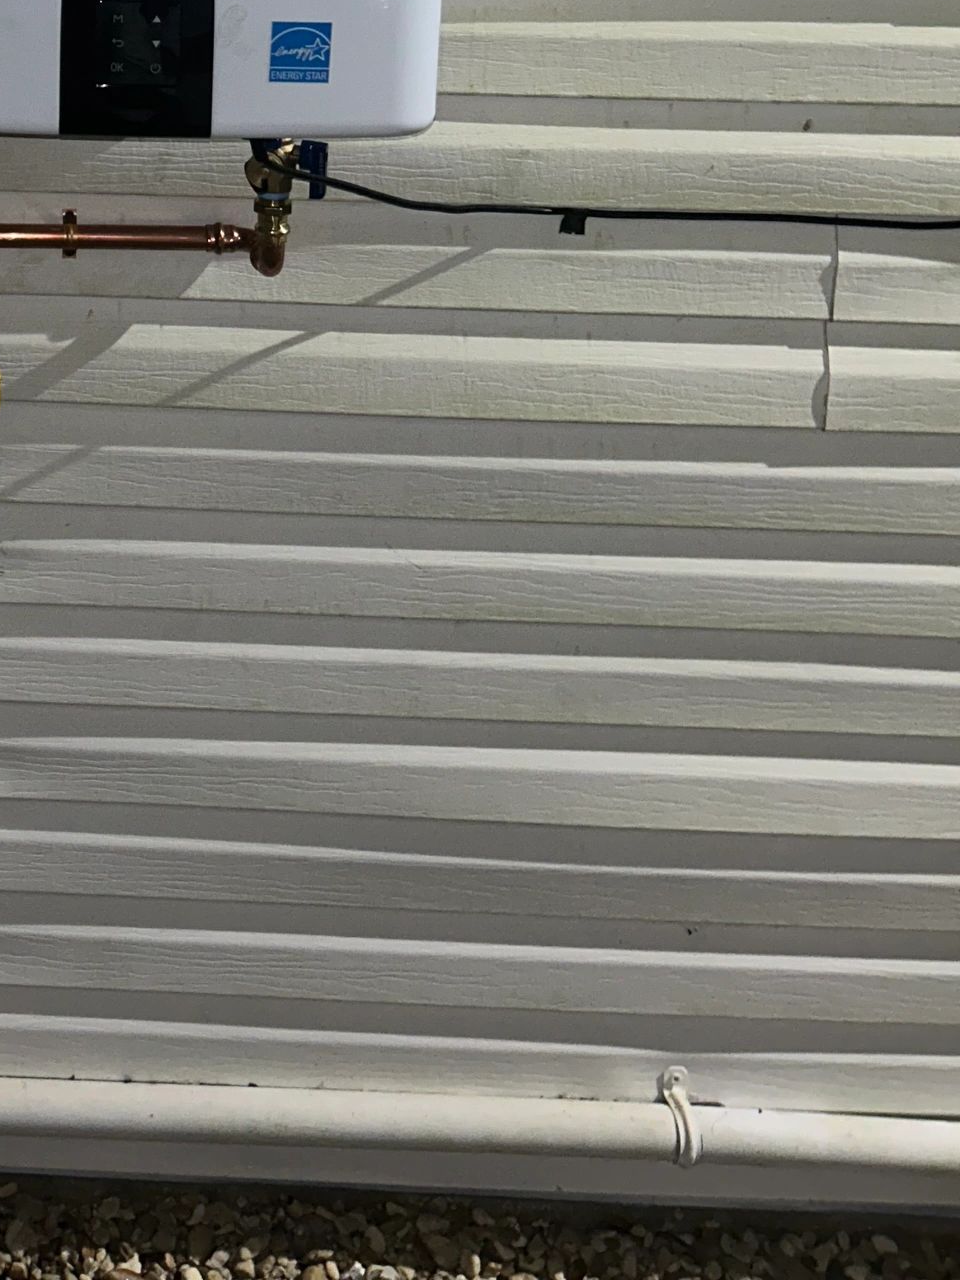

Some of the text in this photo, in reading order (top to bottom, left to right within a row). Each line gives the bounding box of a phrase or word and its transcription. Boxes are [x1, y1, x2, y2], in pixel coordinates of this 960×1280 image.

[110, 63, 125, 73] OK
[271, 70, 328, 81] ENERGY STAR
